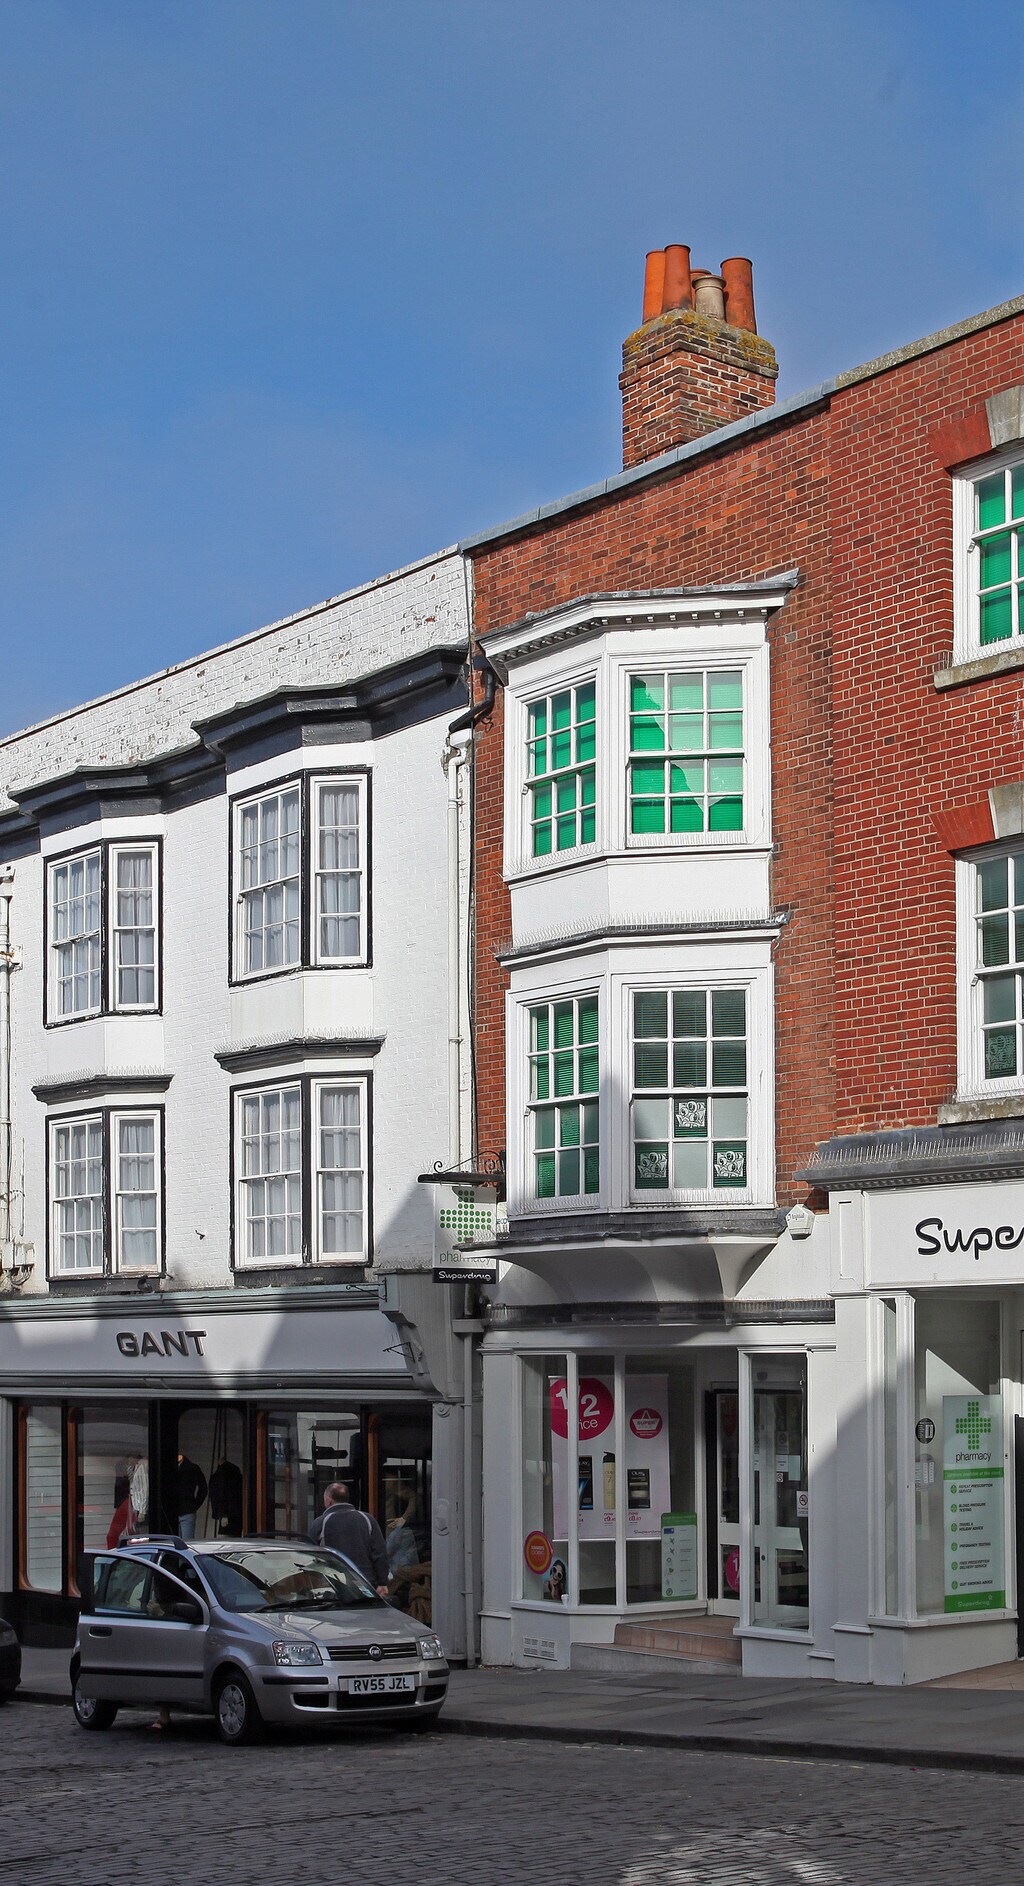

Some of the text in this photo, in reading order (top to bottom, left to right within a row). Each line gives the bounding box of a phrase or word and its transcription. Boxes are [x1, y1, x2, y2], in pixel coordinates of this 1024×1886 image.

[438, 1270, 492, 1282] Superdrug
[116, 1330, 207, 1358] GANT
[955, 1451, 992, 1463] pharmacy
[354, 1678, 410, 1692] RV55 JZL
